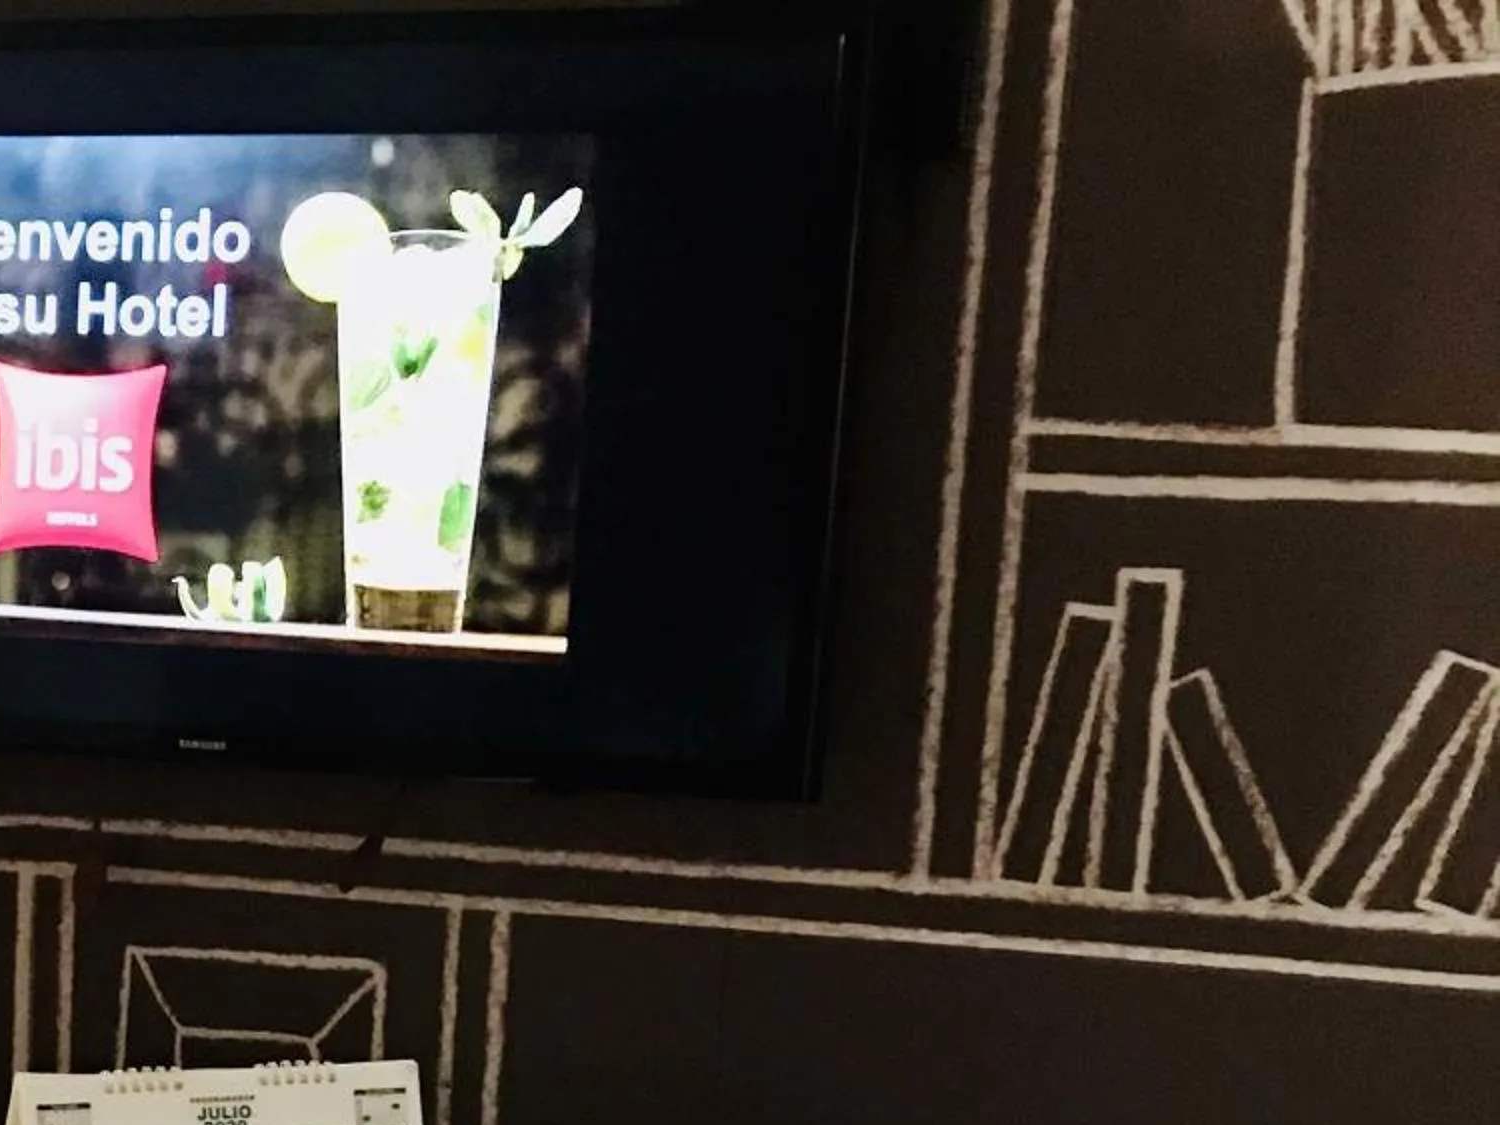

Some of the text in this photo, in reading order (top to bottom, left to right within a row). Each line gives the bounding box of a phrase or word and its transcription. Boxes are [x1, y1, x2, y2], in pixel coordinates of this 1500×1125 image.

[77, 281, 227, 337] Hotel
[15, 418, 134, 493] ibis
[197, 1104, 252, 1120] JULIO
